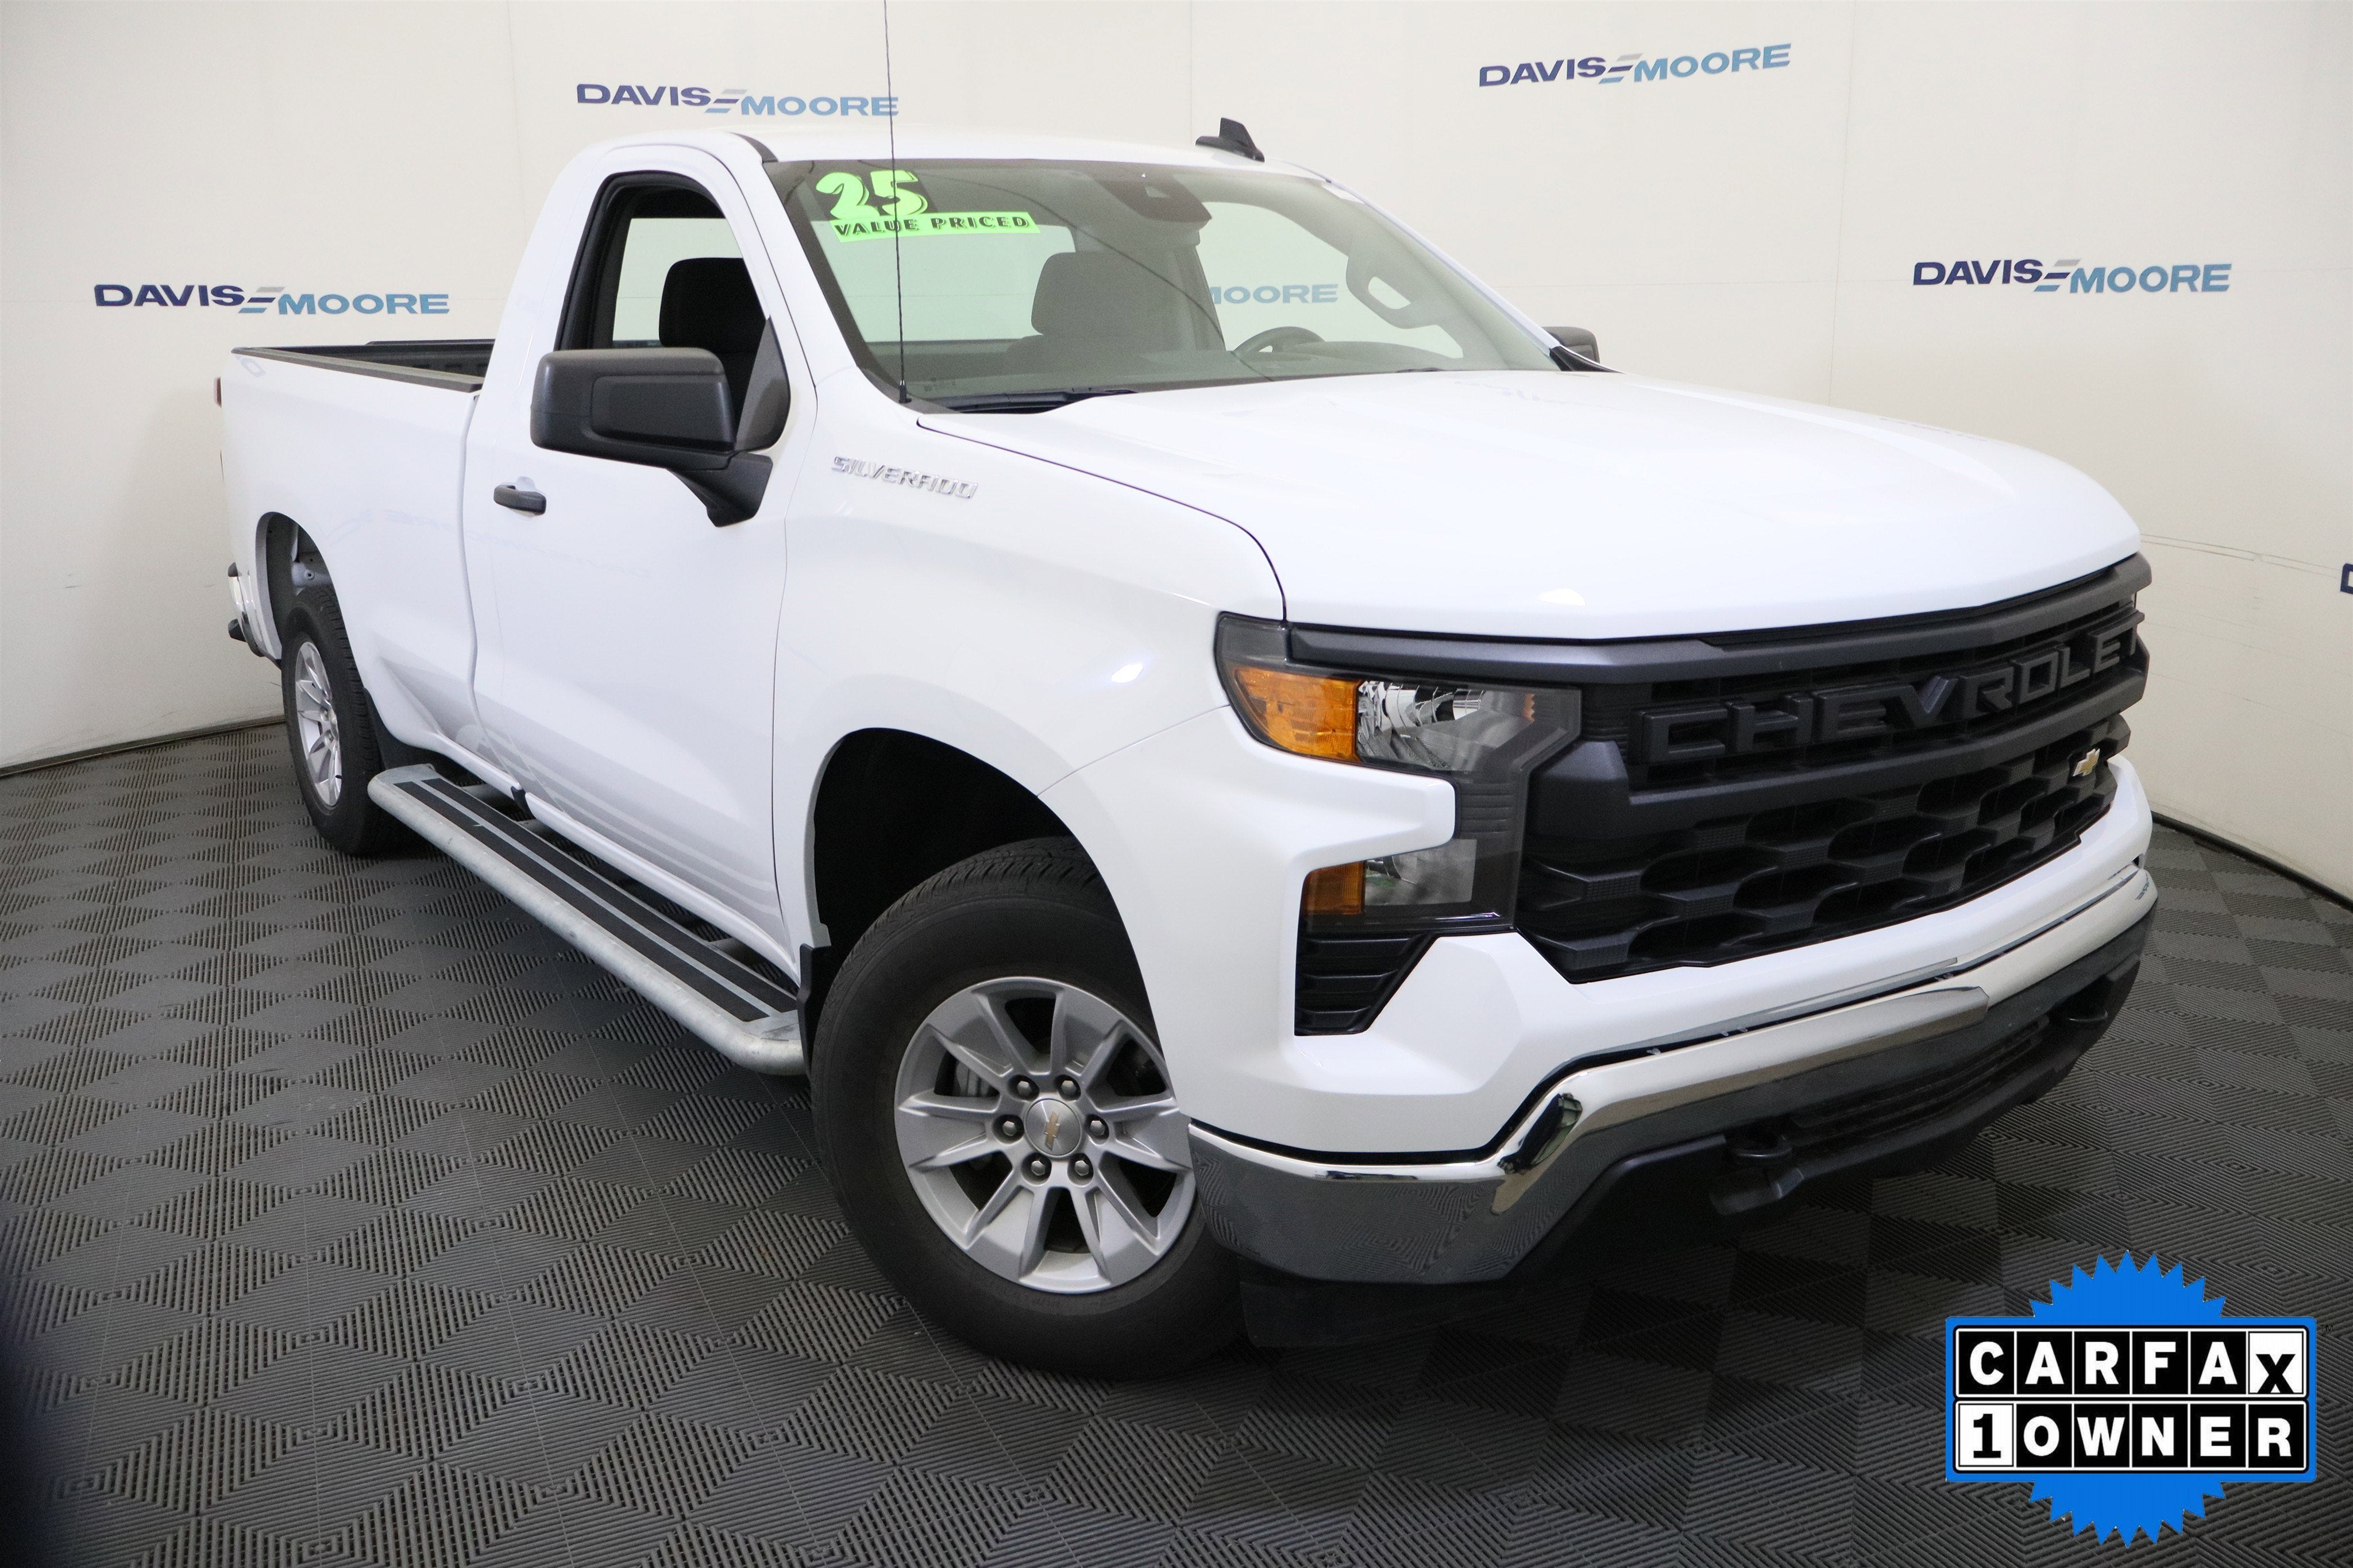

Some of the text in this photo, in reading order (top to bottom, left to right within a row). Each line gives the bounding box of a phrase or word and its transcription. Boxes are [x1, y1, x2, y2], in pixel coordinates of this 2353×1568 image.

[1479, 43, 1792, 87] DAVIS MOORE
[576, 83, 899, 117] DAVIS MOORE
[816, 169, 928, 221] 25
[834, 215, 1031, 237] VALUE PRICED
[1913, 258, 2232, 294] DAVIS MOORE
[94, 284, 450, 315] DAVIS MOORE
[831, 455, 979, 500] SILVERADO
